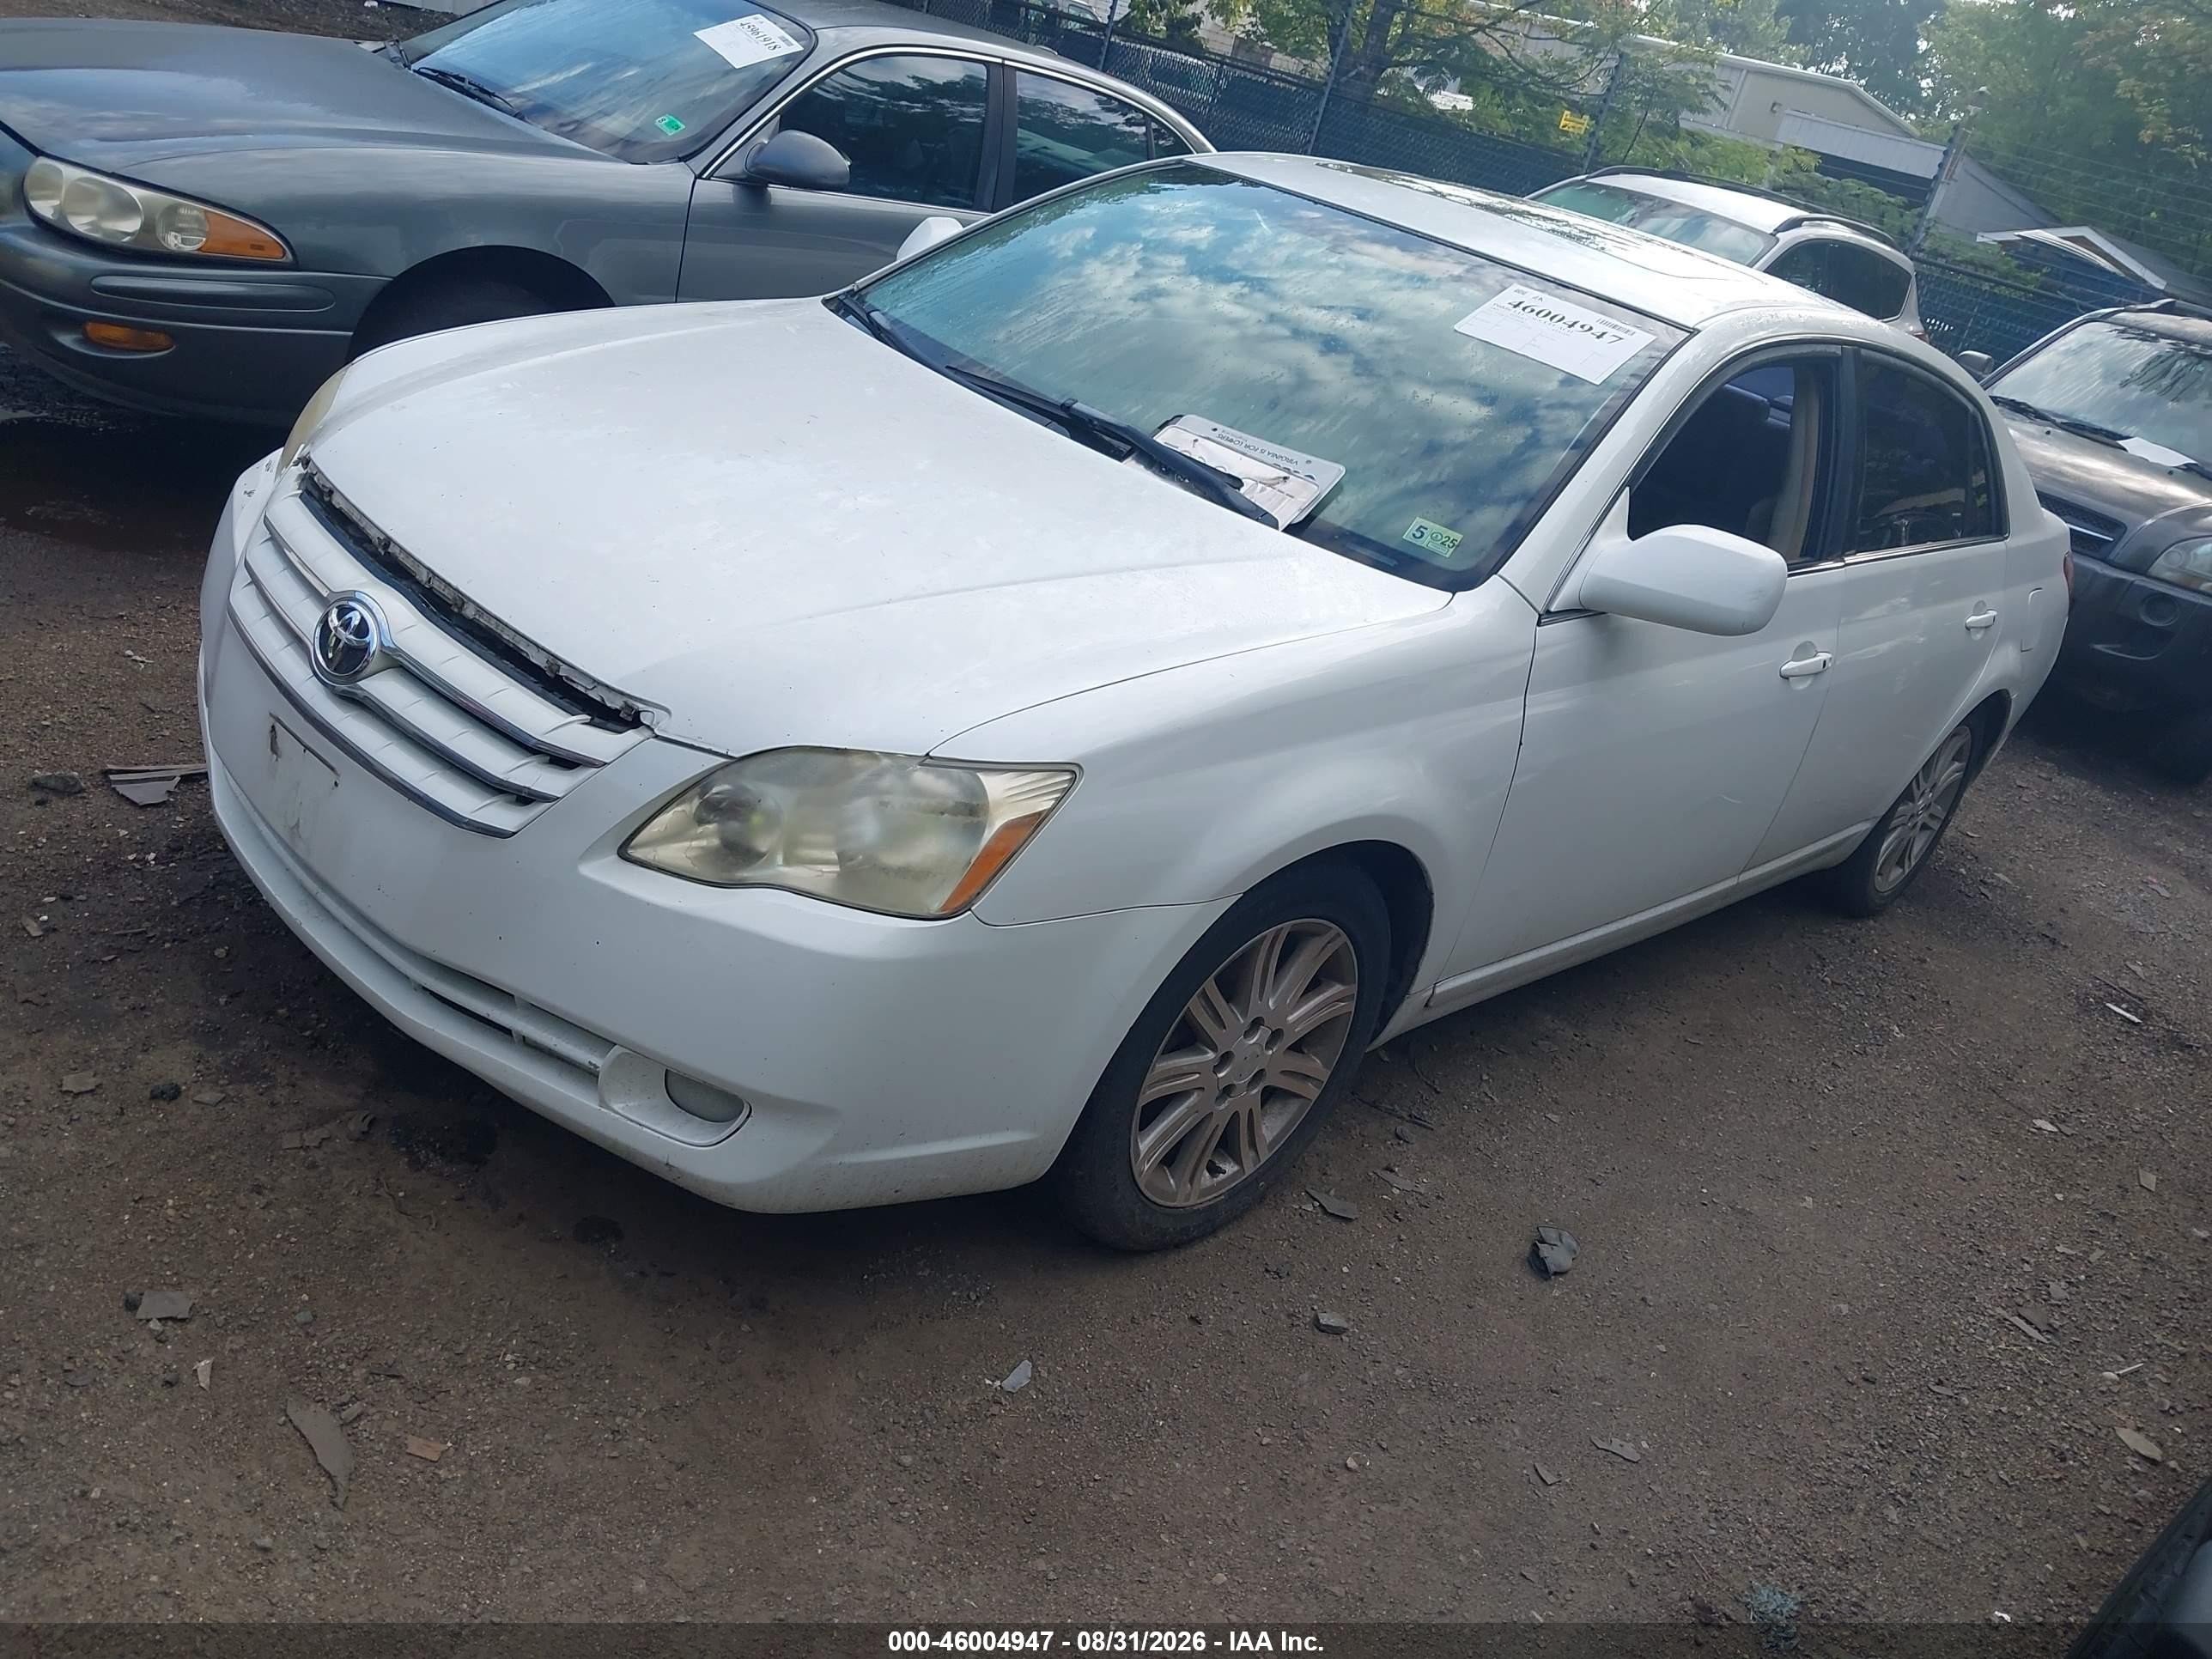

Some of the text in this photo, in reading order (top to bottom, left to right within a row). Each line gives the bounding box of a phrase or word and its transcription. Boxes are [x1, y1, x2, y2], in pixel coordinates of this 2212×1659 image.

[739, 21, 782, 52] 45961918
[1507, 300, 1625, 345] 46004947
[1243, 443, 1259, 453] FOR
[1267, 450, 1298, 466] VIRGINIA
[1412, 525, 1428, 539] 5
[1440, 536, 1458, 549] 25
